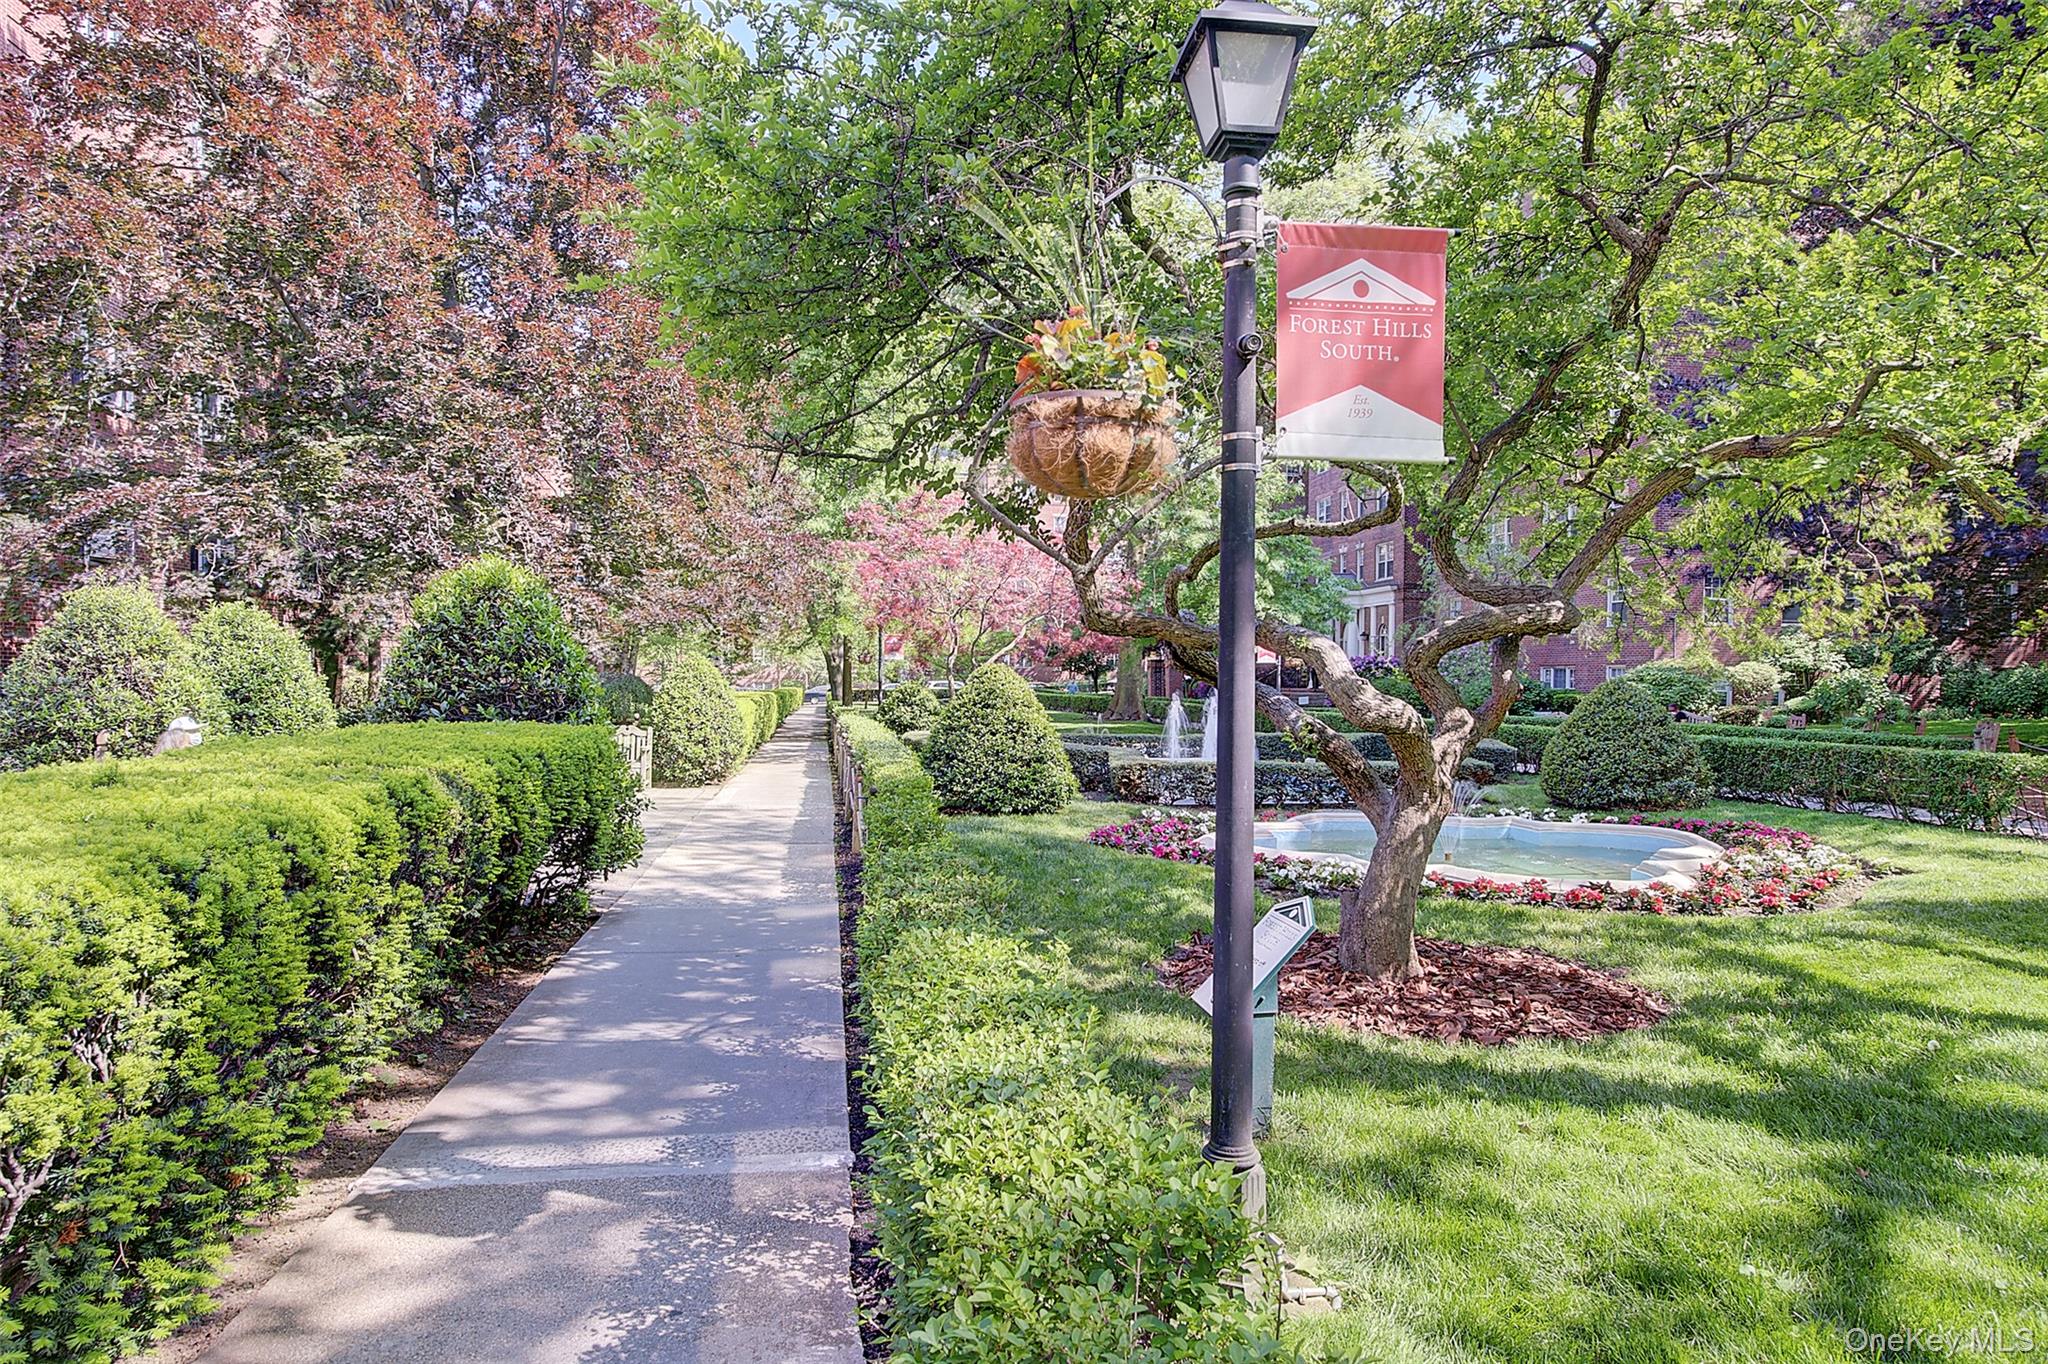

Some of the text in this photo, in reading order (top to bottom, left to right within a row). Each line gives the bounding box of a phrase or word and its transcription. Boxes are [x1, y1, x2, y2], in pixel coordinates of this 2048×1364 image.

[1289, 314, 1432, 338] FOREST HILLS
[1353, 394, 1370, 405] Est.
[1347, 408, 1373, 418] 1939
